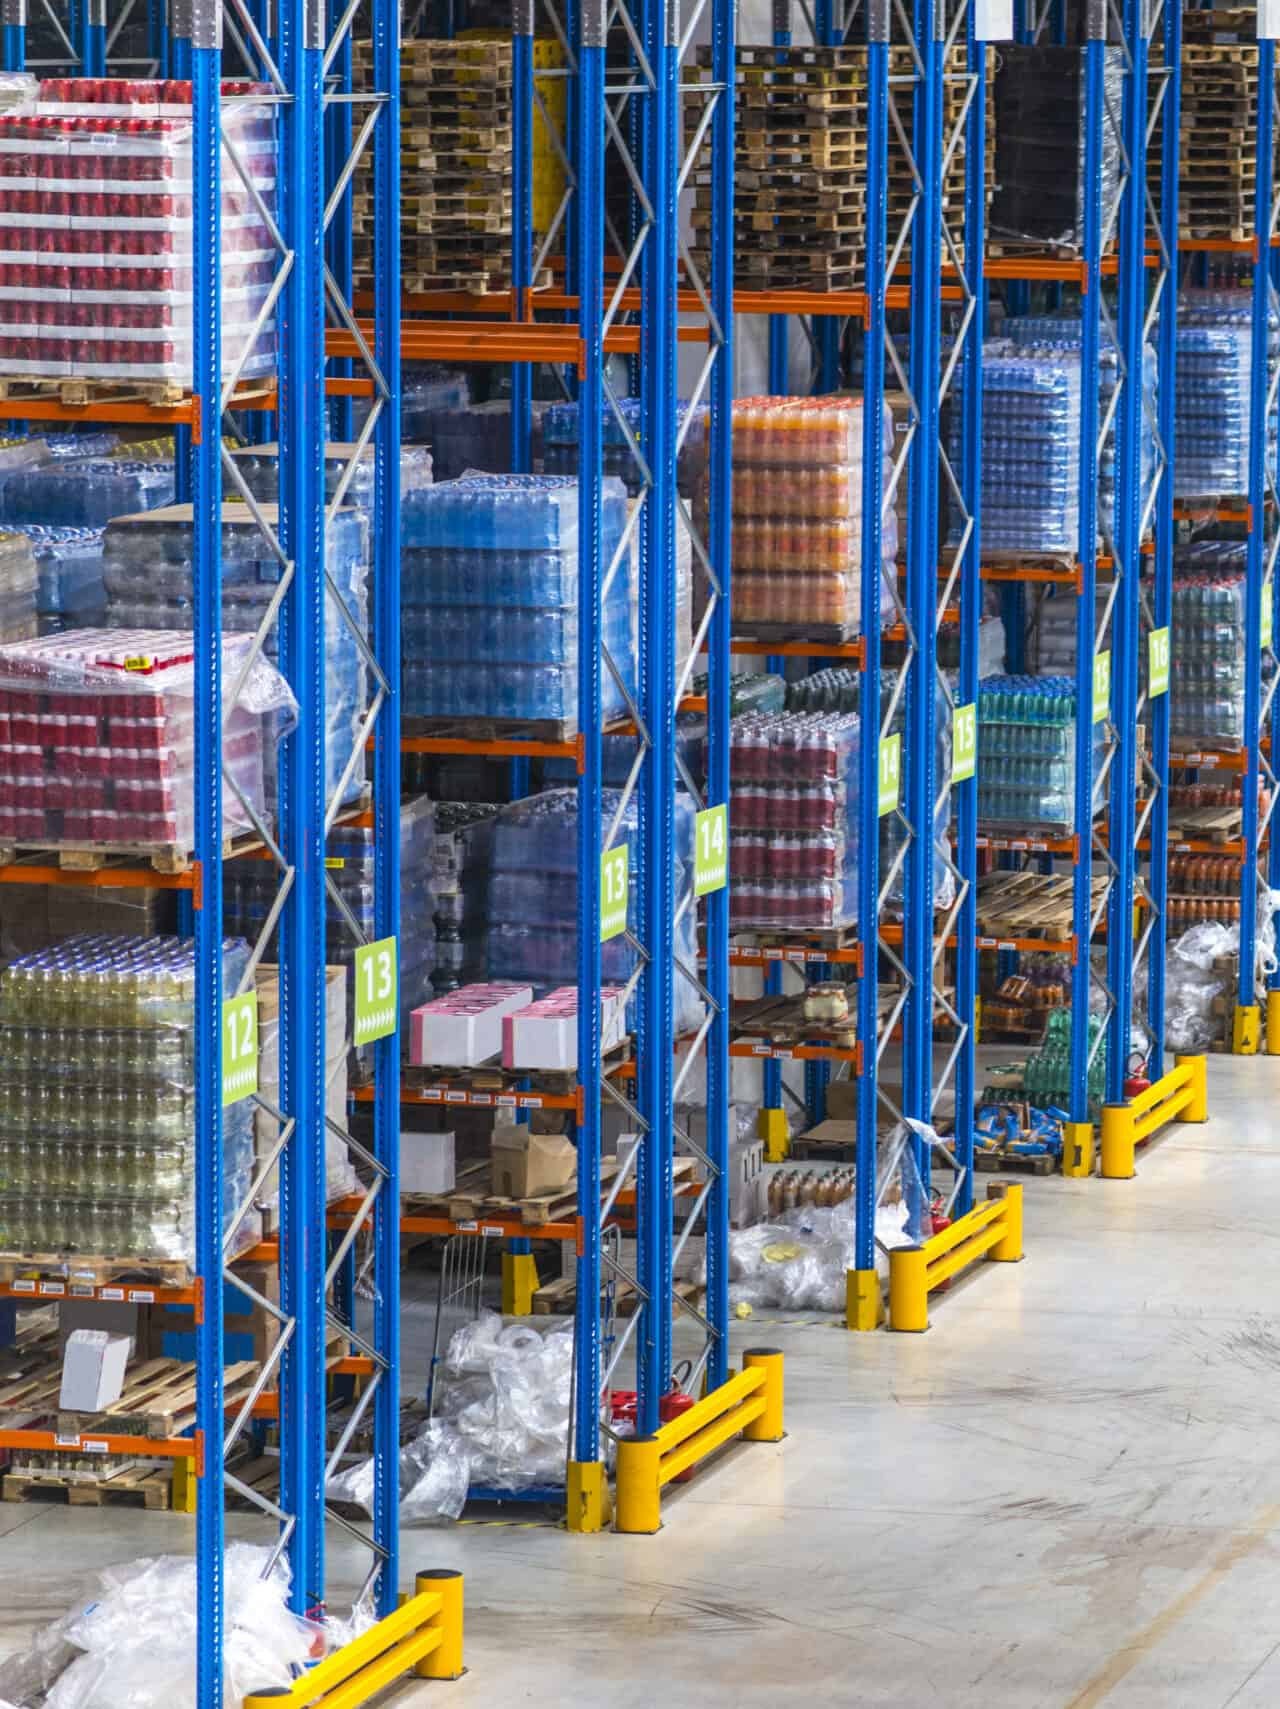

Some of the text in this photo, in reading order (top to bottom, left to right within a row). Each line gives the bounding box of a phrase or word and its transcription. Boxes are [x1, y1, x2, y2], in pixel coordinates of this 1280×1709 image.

[1153, 636, 1168, 669] 16
[957, 716, 973, 753] 15
[882, 744, 898, 783] 14
[701, 815, 724, 860] 14
[604, 857, 625, 903] 13
[363, 951, 392, 1003] 13
[227, 1005, 254, 1061] 12
